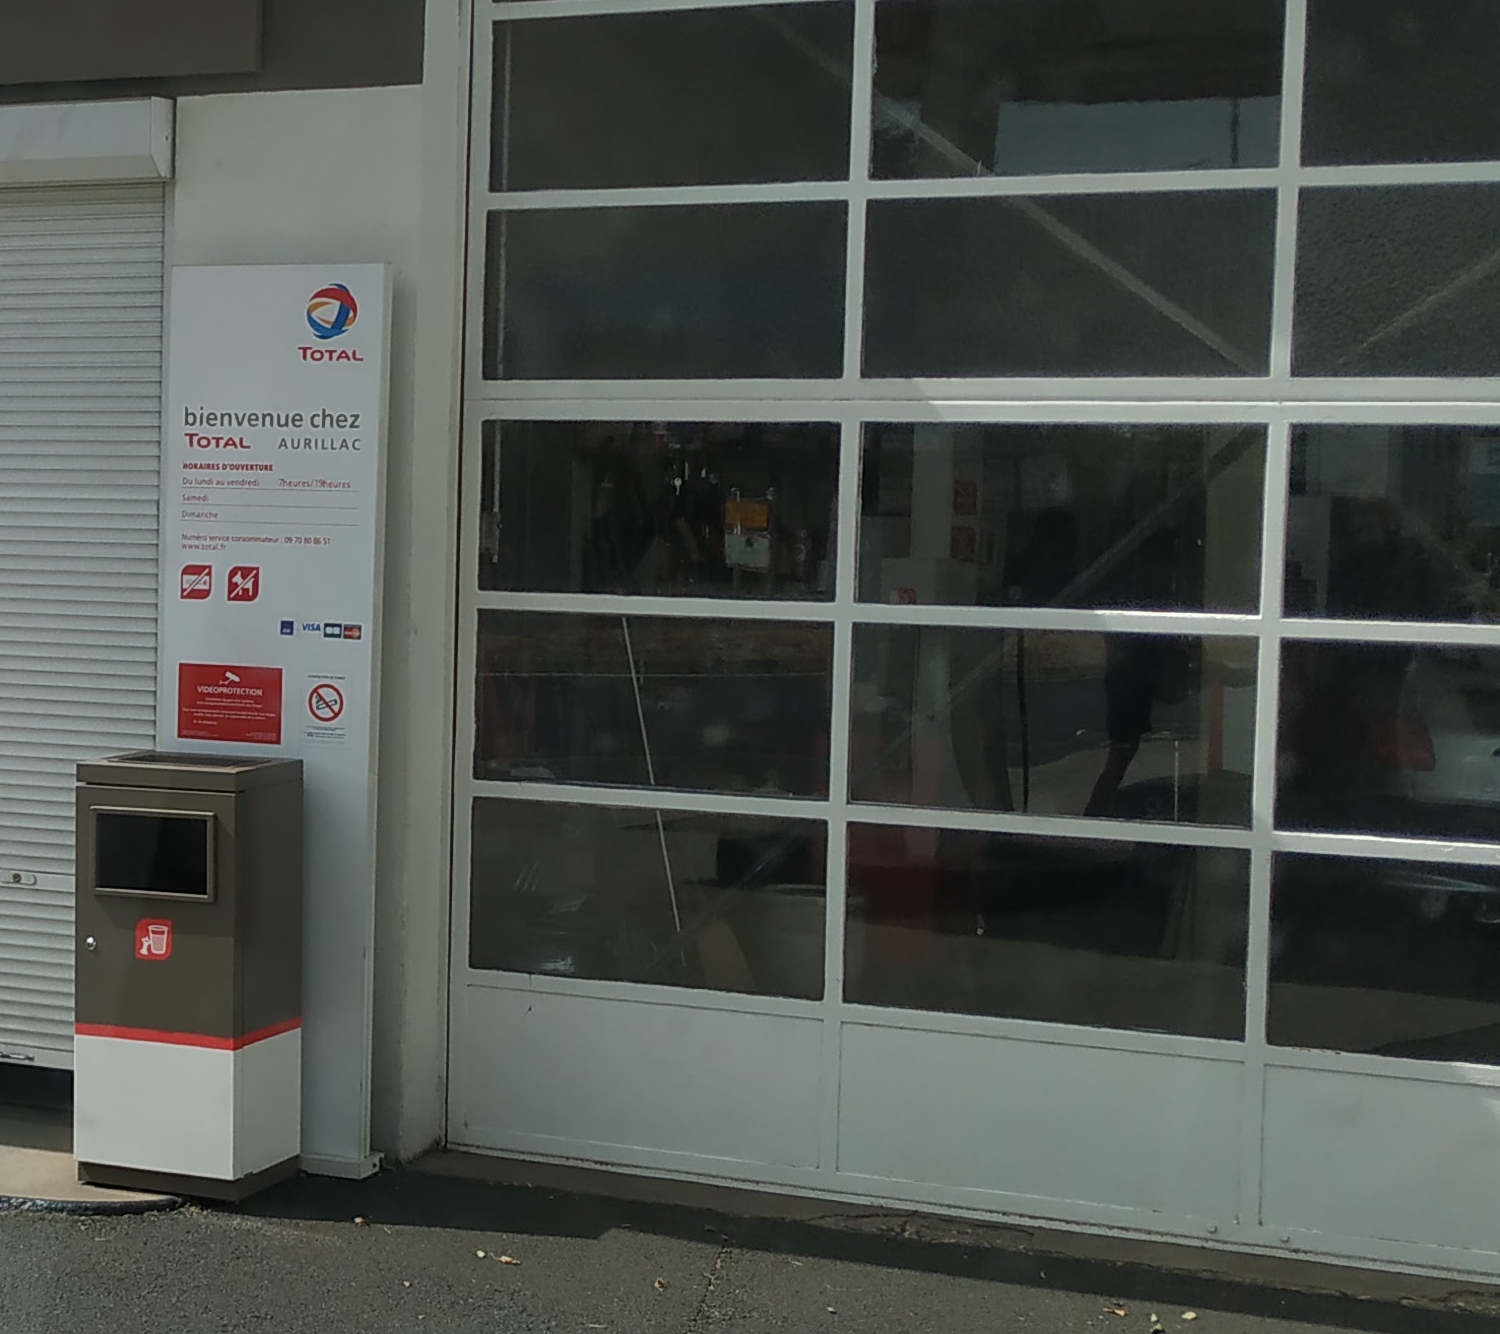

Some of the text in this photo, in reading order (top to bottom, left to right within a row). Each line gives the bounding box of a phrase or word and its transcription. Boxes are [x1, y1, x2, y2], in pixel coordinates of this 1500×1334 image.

[298, 347, 364, 361] TOTAL
[184, 406, 360, 429] bienvenue chez
[184, 433, 362, 451] TOTAL AURILLAC
[182, 462, 274, 472] HORAIRES D'OUVERTURE
[182, 477, 193, 485] Du
[194, 478, 213, 486] lundi
[226, 479, 260, 487] vendredi
[182, 493, 209, 502] Samedi
[182, 510, 218, 518] Dimanche
[182, 533, 207, 542] Numéro
[208, 534, 230, 542] service
[231, 535, 279, 543] consommateur
[284, 536, 293, 544] 09
[303, 537, 312, 545] 80
[181, 543, 226, 551] www.total.fr
[302, 623, 321, 632] VISA
